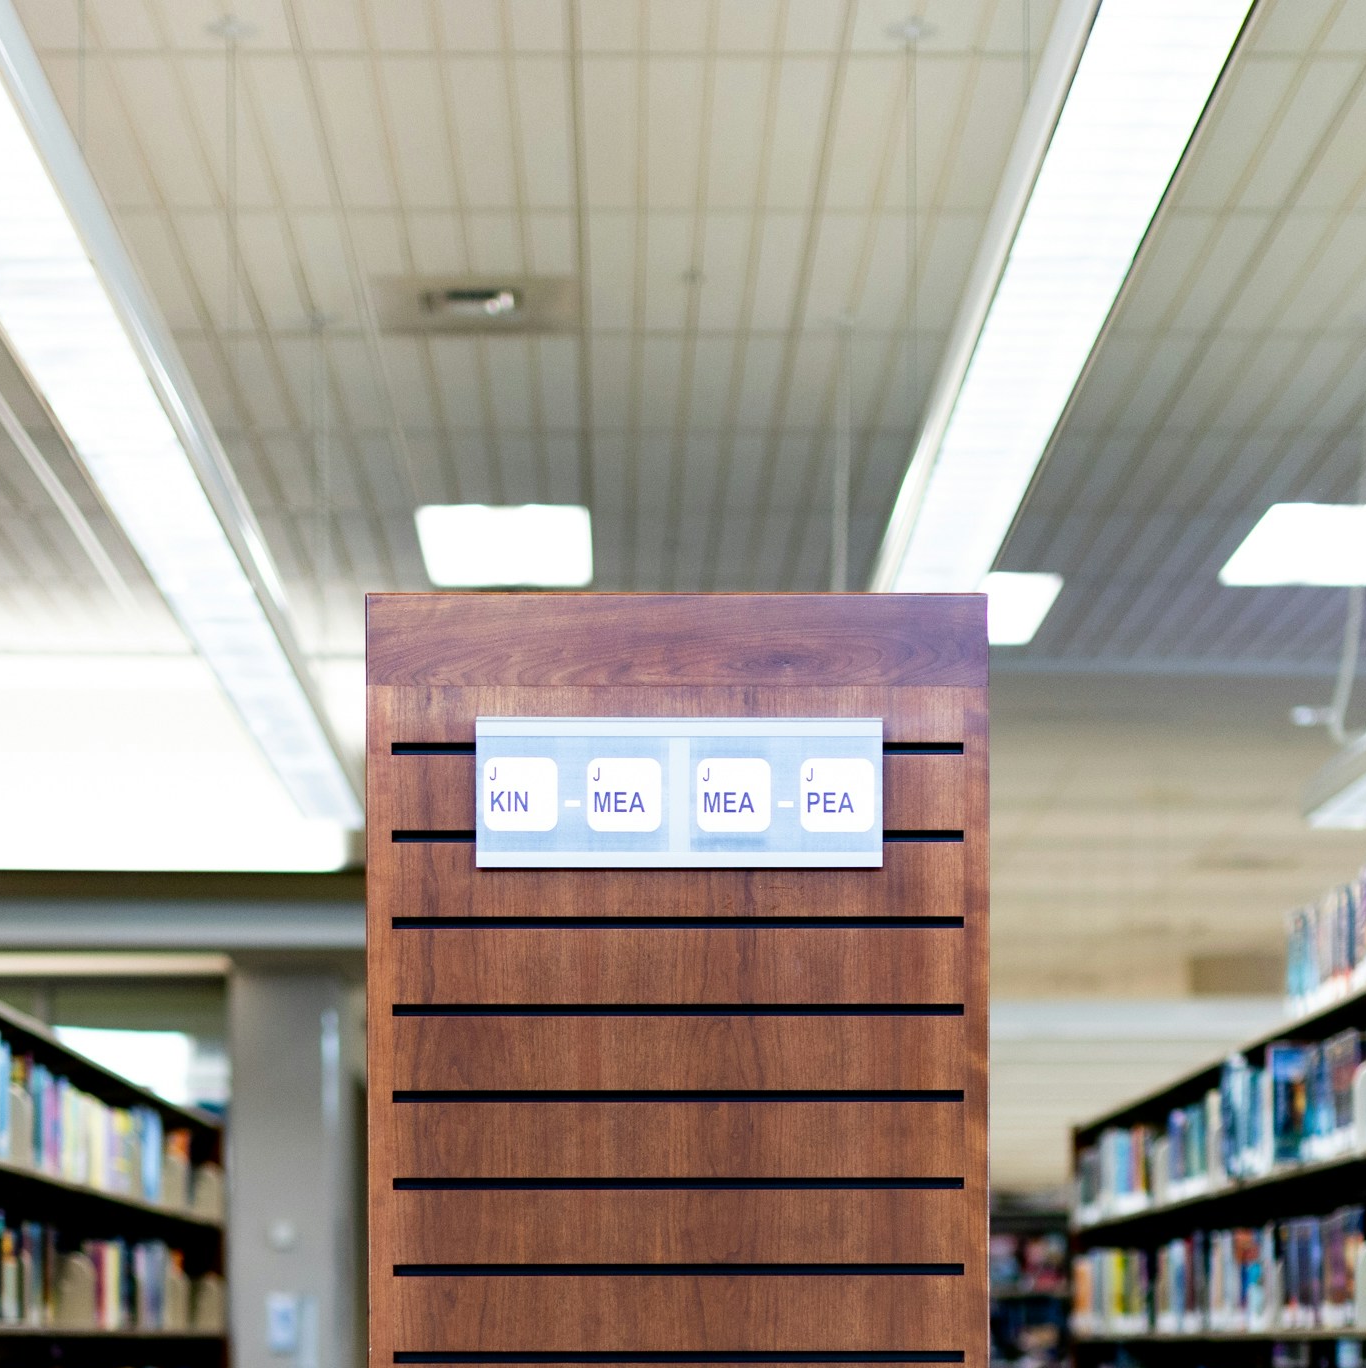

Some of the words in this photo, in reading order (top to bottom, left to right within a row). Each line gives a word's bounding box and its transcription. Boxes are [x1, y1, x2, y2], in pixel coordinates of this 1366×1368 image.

[490, 767, 496, 781] J
[593, 768, 600, 781] J
[703, 768, 709, 781] J
[806, 768, 813, 782] J
[491, 791, 528, 812] KIN
[594, 792, 645, 812] MEA
[704, 792, 754, 813] MEA
[808, 792, 854, 813] PEA
